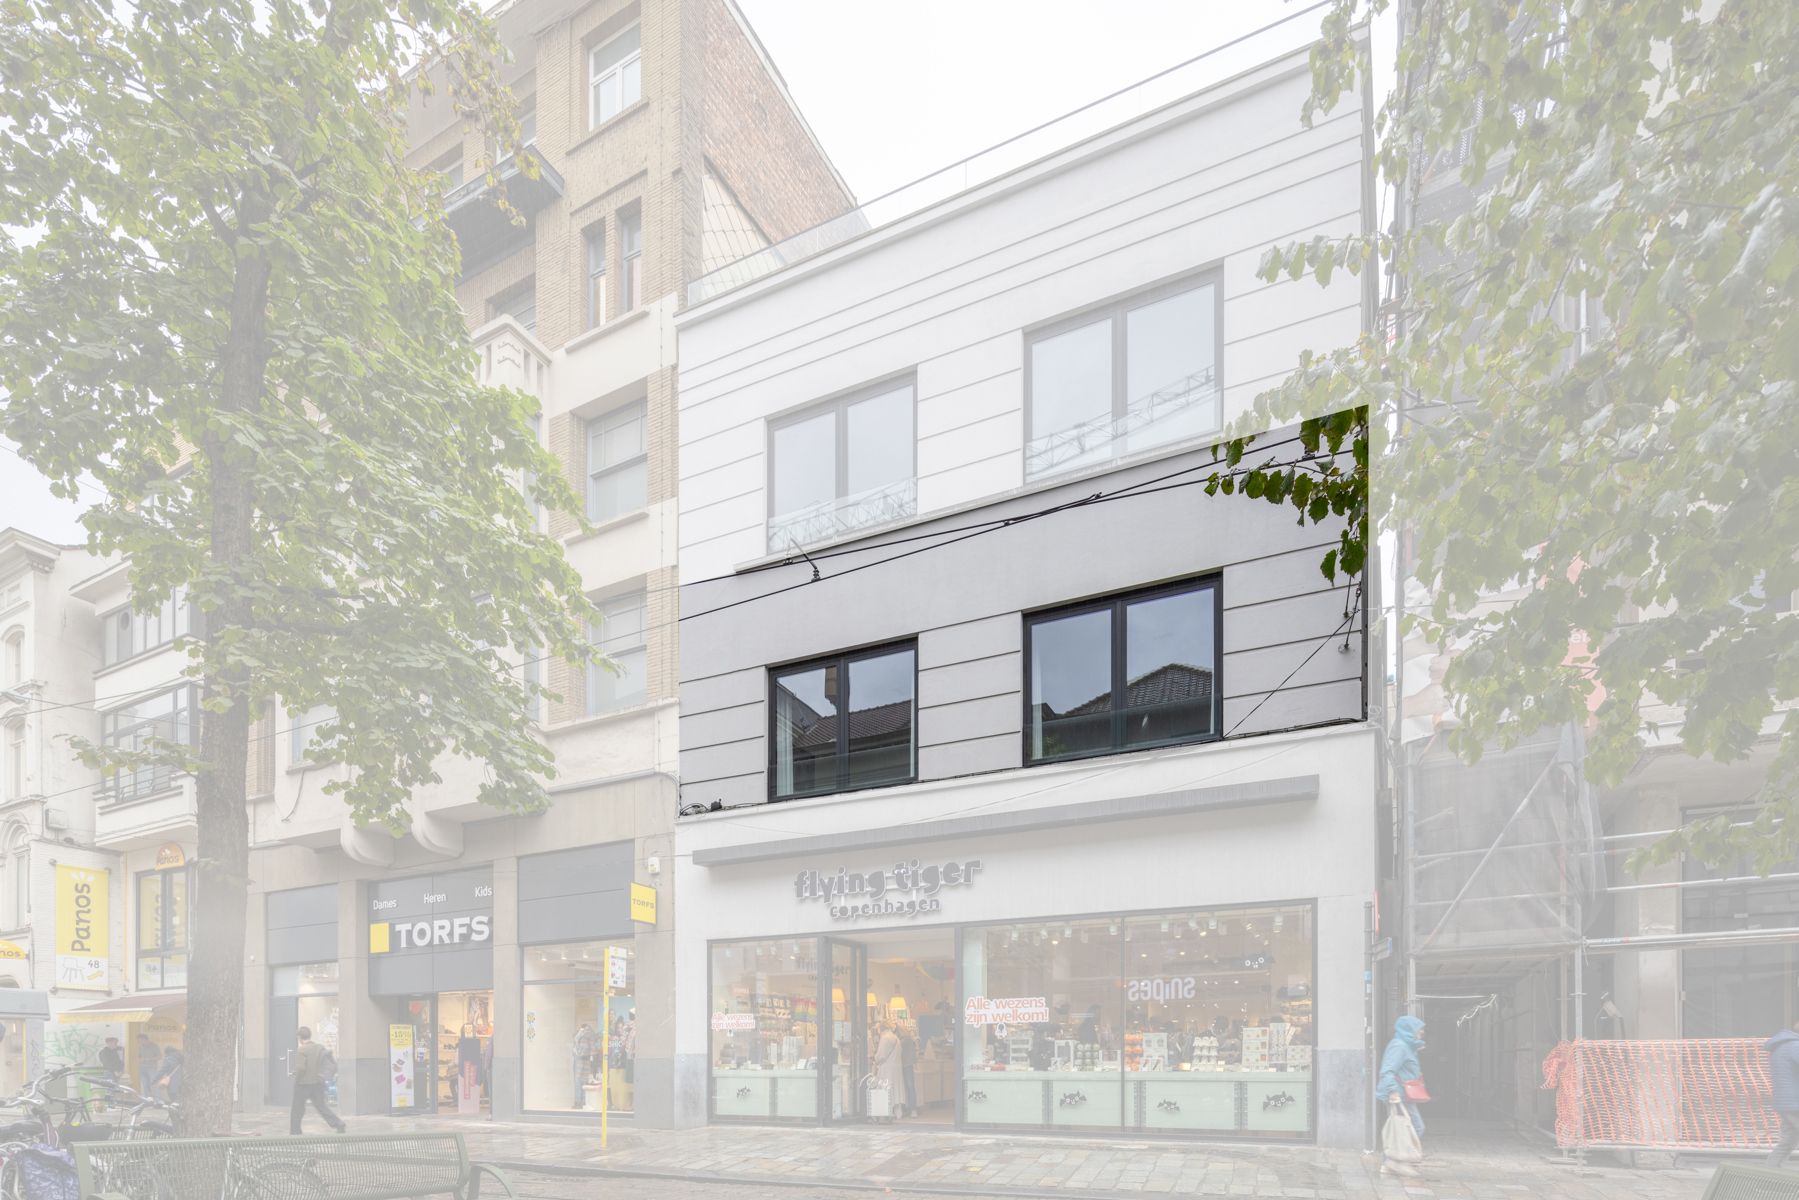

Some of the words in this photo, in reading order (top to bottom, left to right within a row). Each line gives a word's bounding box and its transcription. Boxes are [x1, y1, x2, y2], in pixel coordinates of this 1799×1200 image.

[794, 866, 886, 904] flying
[893, 858, 984, 896] tiger
[474, 885, 493, 898] Kids
[373, 899, 397, 910] Dames
[423, 893, 447, 904] Heren
[632, 898, 655, 909] TORFS
[830, 898, 941, 920] copenhagen
[71, 882, 91, 952] Panos
[395, 916, 490, 948] TORFS
[0, 950, 21, 958] nos
[88, 959, 100, 969] 48
[967, 998, 990, 1010] Alle
[994, 998, 1044, 1009] wezens
[966, 1010, 988, 1026] zijn
[991, 1008, 1048, 1022] welkom!
